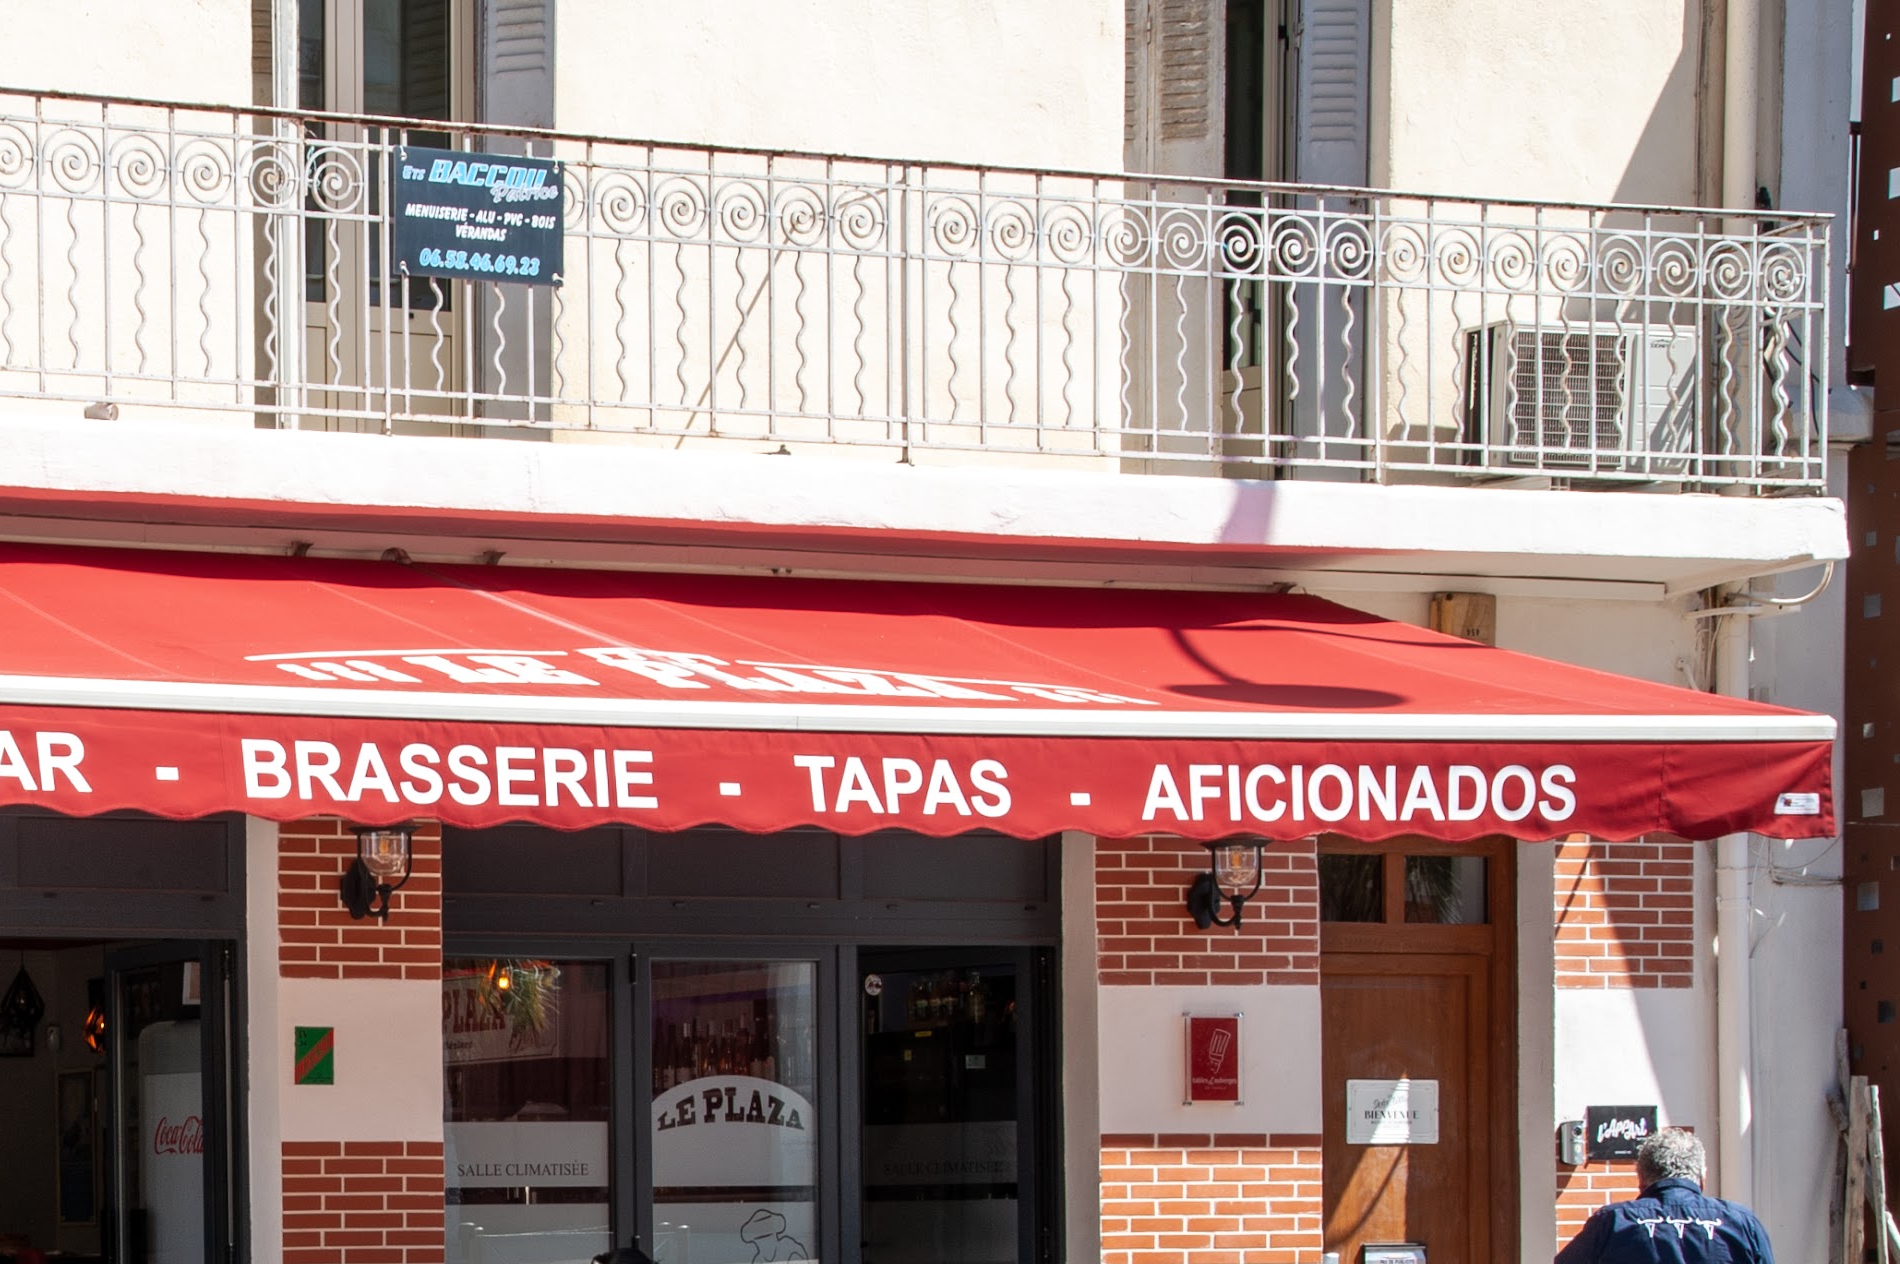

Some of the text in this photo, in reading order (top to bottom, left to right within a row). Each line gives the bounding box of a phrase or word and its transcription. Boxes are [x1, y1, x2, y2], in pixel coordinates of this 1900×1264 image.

[428, 159, 548, 191] BACCOU
[490, 185, 559, 204] Patrice
[405, 203, 468, 222] MENUISERIE
[475, 209, 496, 223] ALU
[504, 212, 524, 227] PVC
[531, 215, 556, 229] BOIS
[455, 222, 507, 242] VÉRANDAS
[419, 248, 540, 277] 06.58.46.69.23
[240, 738, 659, 809] BRASSERIE
[793, 755, 1012, 818] TAPAS
[1141, 763, 1577, 823] AFICIONADOS
[657, 1087, 806, 1131] LE PLAZA
[1364, 1110, 1419, 1119] BIENVENUE
[457, 1160, 589, 1177] SALLE CLIMATISÉE
